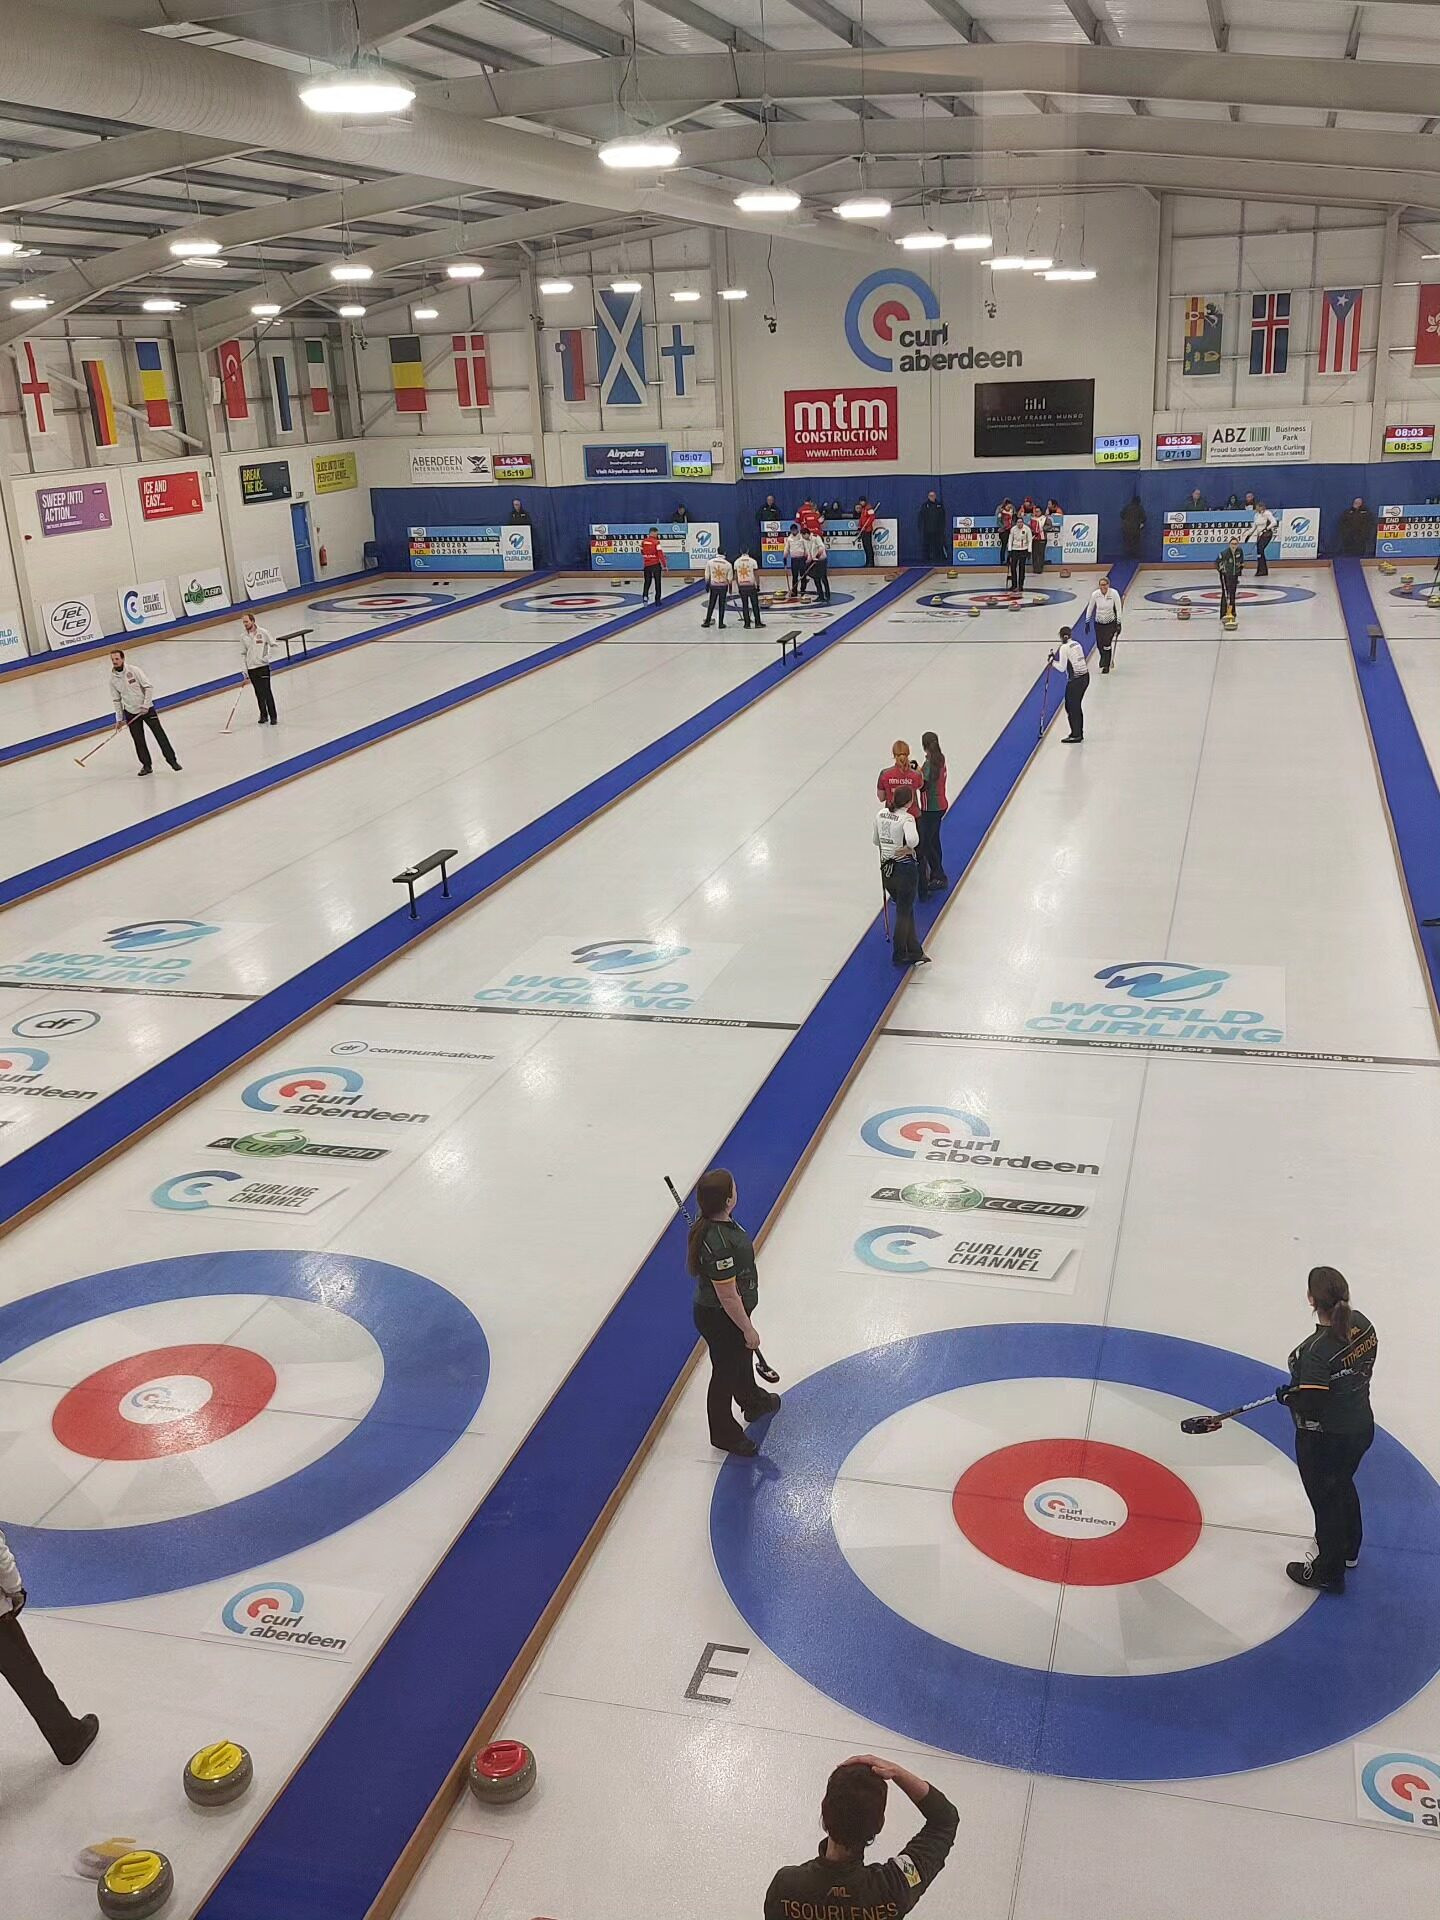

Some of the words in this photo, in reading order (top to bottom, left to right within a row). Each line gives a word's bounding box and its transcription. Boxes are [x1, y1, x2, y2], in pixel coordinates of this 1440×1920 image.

[900, 322, 948, 347] curl
[900, 346, 1022, 372] aberdeen
[794, 394, 888, 430] mtm
[794, 430, 888, 444] CONSTRUCTION
[1212, 428, 1246, 444] ABZ
[1395, 428, 1424, 436] 08:03
[1103, 439, 1130, 447] 08:10
[1166, 436, 1193, 444] 05:32
[1394, 442, 1422, 450] 08:35
[606, 449, 646, 460] Airparks
[806, 446, 878, 458] www.mtm.co.uk
[1103, 452, 1130, 460] 08:05
[1166, 450, 1191, 458] 07:19
[412, 456, 462, 466] ABERDEEN
[744, 458, 750, 466] C
[243, 468, 261, 481] BREAK
[144, 480, 154, 494] ICE
[154, 479, 167, 494] AND
[244, 481, 254, 493] THE
[42, 492, 67, 508] SWEEP
[67, 490, 84, 506] INTO
[255, 567, 279, 581] CURLIT
[54, 606, 84, 621] Jet
[62, 619, 86, 631] Ice
[24, 952, 192, 970] WORLD
[0, 964, 186, 984] CURLING
[474, 988, 700, 1010] CURLNG
[387, 1002, 479, 1013] @worldcurling
[518, 1009, 612, 1020] @worldcurling
[652, 1016, 750, 1028] @worldcurling
[1049, 1001, 1266, 1025] WORLD
[35, 1018, 83, 1029] df
[1024, 1016, 1286, 1044] CURLING
[369, 1047, 495, 1060] communications
[940, 1031, 1059, 1045] worldcurling.org
[1088, 1040, 1213, 1054] worldcurling.org
[1244, 1048, 1376, 1064] worldcurling.org
[0, 1074, 43, 1084] url
[0, 1086, 98, 1099] erdeen
[299, 1093, 364, 1106] curl
[282, 1102, 430, 1124] aberdeen
[931, 1138, 1000, 1152] curl
[925, 1150, 1100, 1175] aberdeen
[242, 1183, 320, 1197] CURLING
[228, 1192, 307, 1208] CHANNEL
[984, 1200, 1078, 1216] CLEAN
[954, 1241, 1042, 1259] CURLING
[948, 1252, 1040, 1272] CHANNEL
[1341, 1333, 1377, 1368] TITHERIDG
[1058, 1514, 1116, 1526] aberdeen
[261, 1614, 304, 1628] curl
[250, 1626, 347, 1650] aberdeen
[684, 1642, 750, 1705] E
